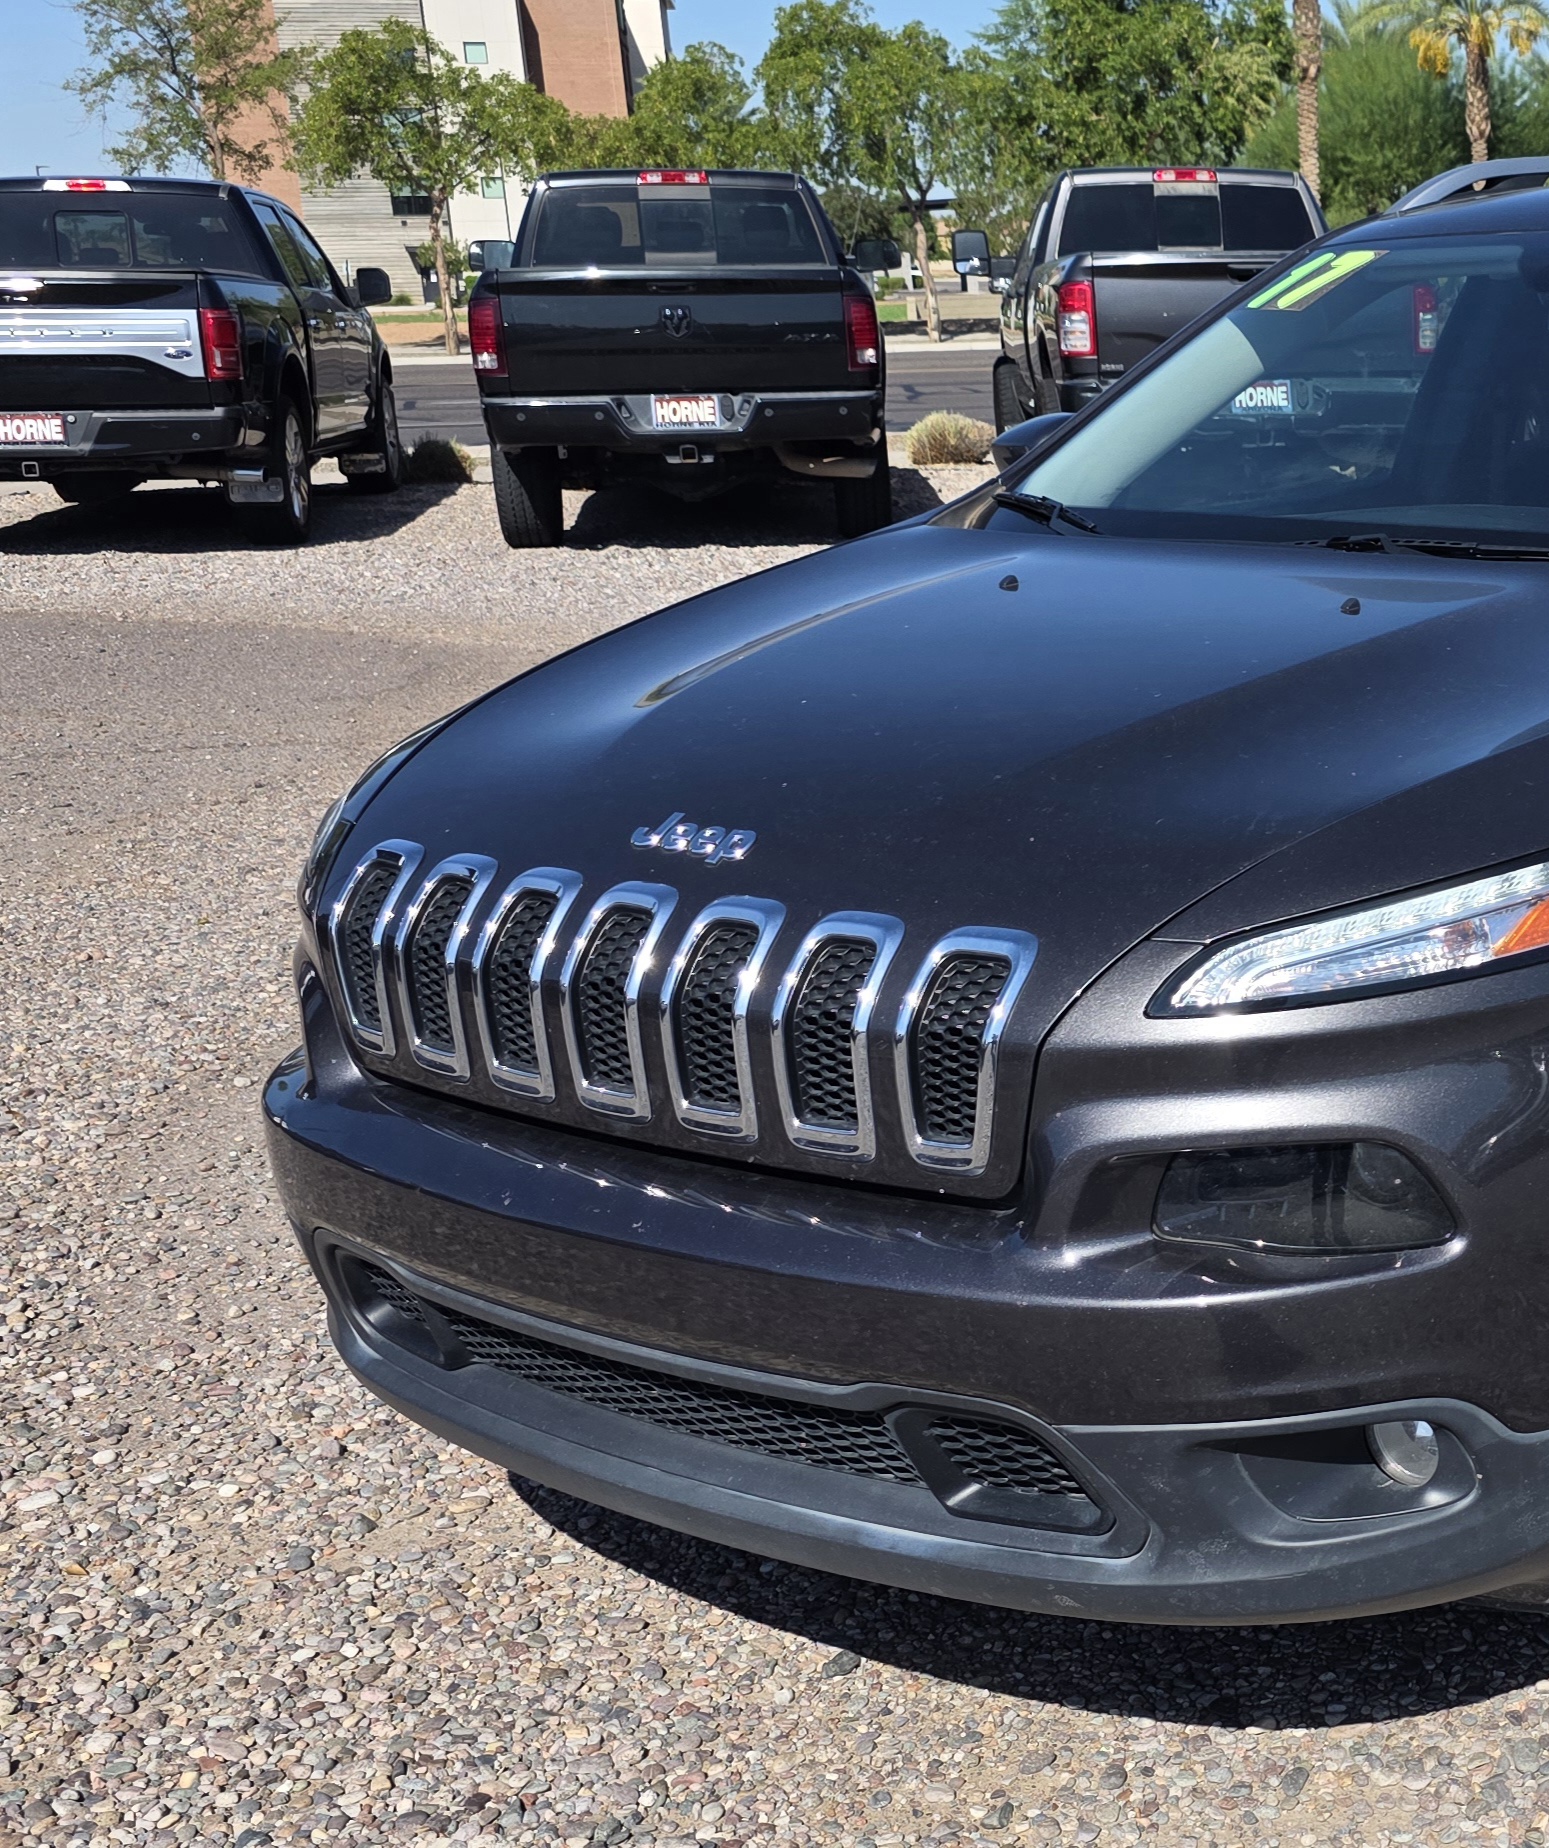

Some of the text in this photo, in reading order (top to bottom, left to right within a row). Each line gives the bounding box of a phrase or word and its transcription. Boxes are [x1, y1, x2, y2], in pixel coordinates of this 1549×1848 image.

[1246, 251, 1376, 309] 17
[0, 418, 64, 441] HORNE
[655, 400, 716, 423] HORNE
[630, 812, 757, 864] Jeep
